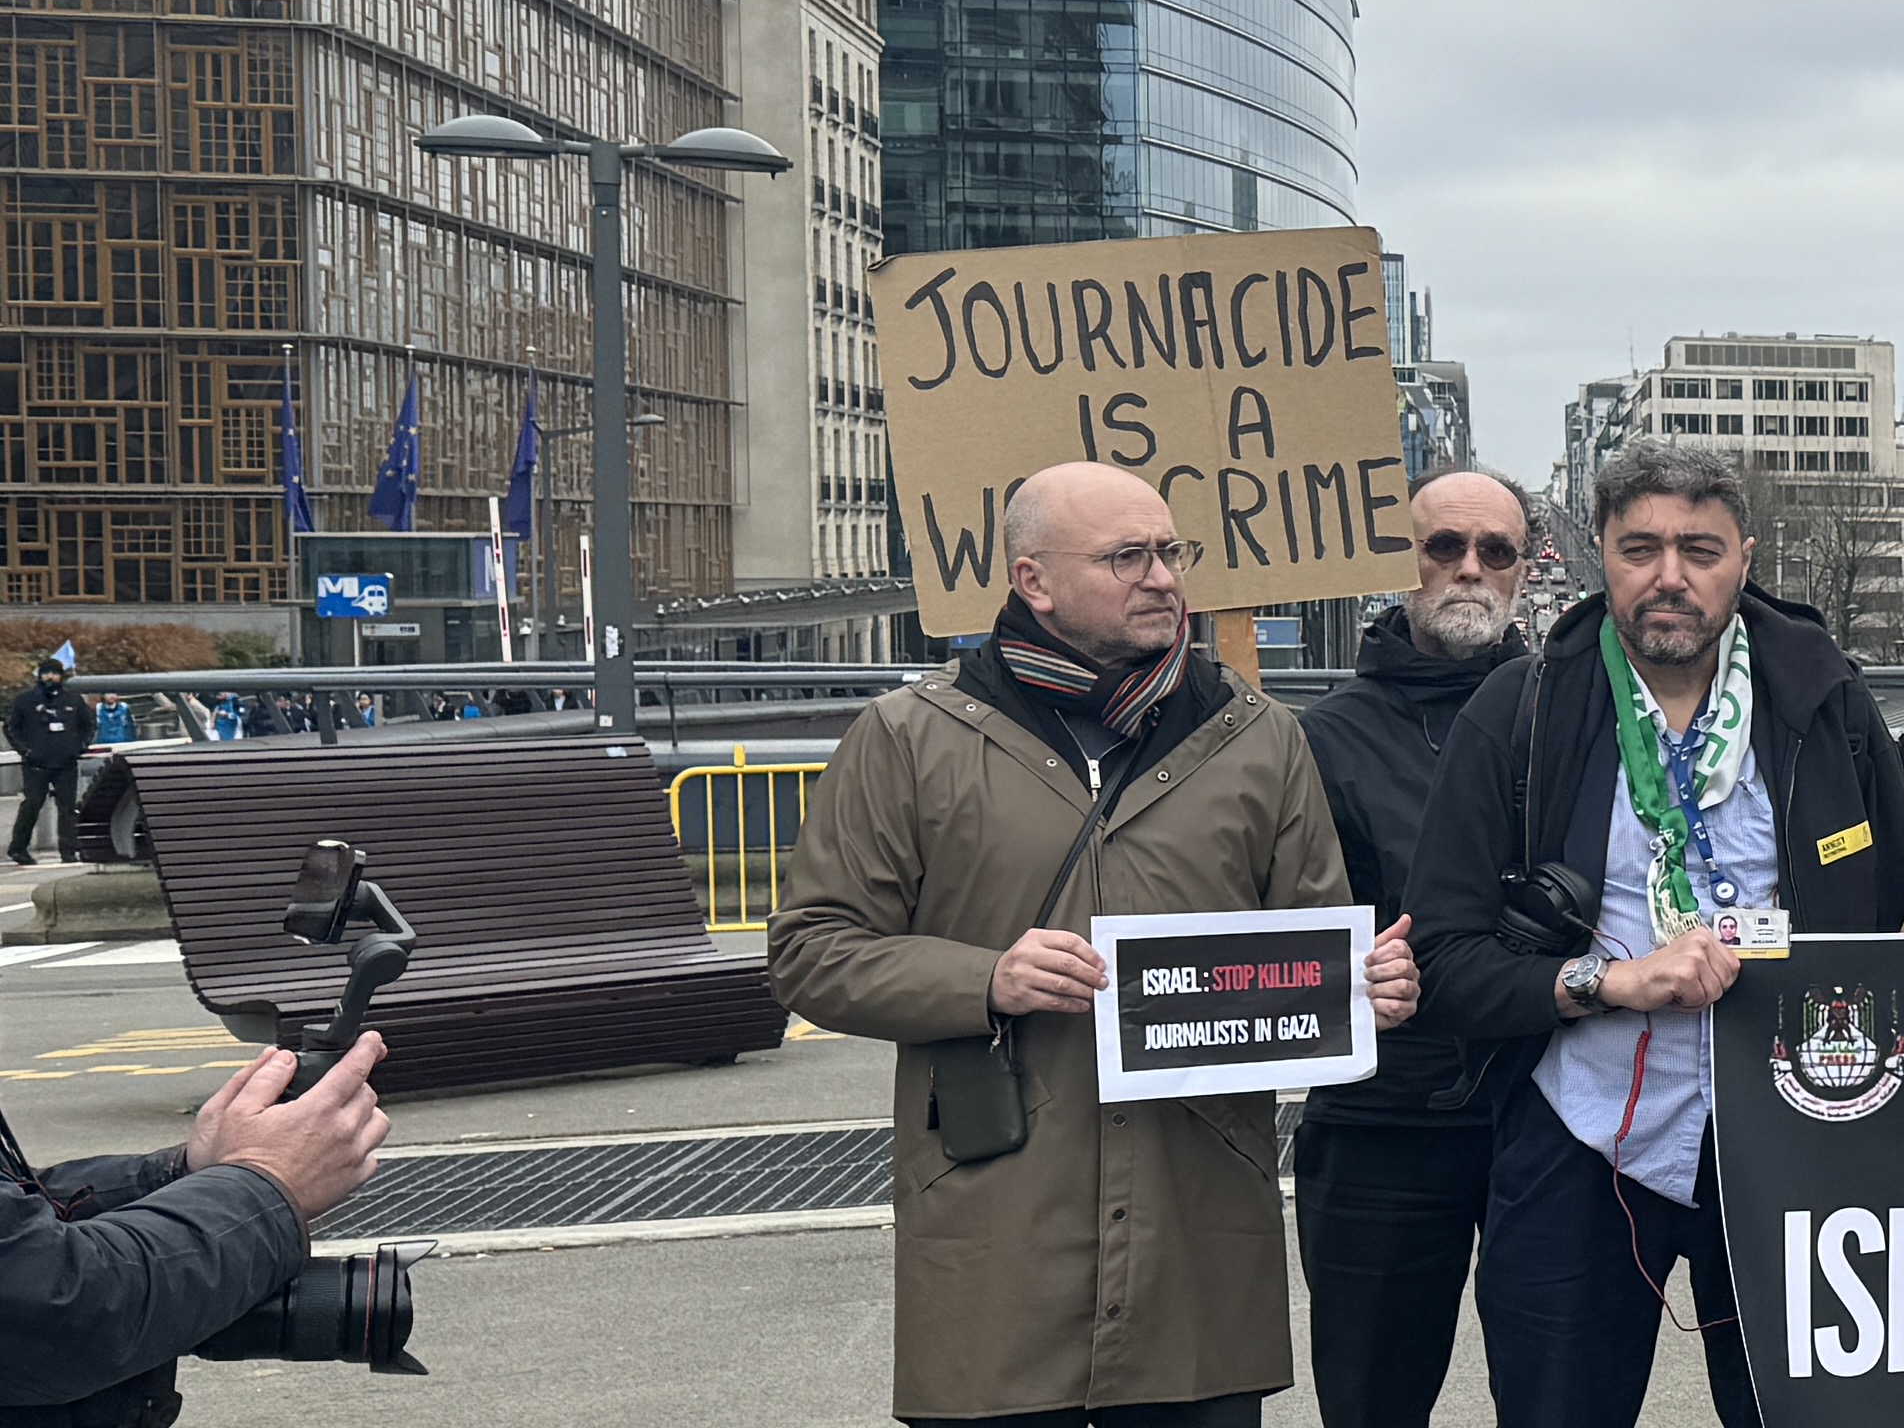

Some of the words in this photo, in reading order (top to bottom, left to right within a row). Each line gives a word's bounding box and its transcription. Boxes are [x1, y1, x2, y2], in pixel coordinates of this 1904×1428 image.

[904, 262, 1385, 390] JOURNACIDE
[1078, 392, 1157, 466] IS
[1228, 385, 1275, 459] A
[1142, 967, 1209, 996] ISRAEL:
[1212, 964, 1255, 992] STOP
[1258, 961, 1321, 989] KILLING
[1144, 1020, 1249, 1051] JOURNALISTS
[1254, 1018, 1272, 1043] IN
[1277, 1014, 1320, 1041] GAZA
